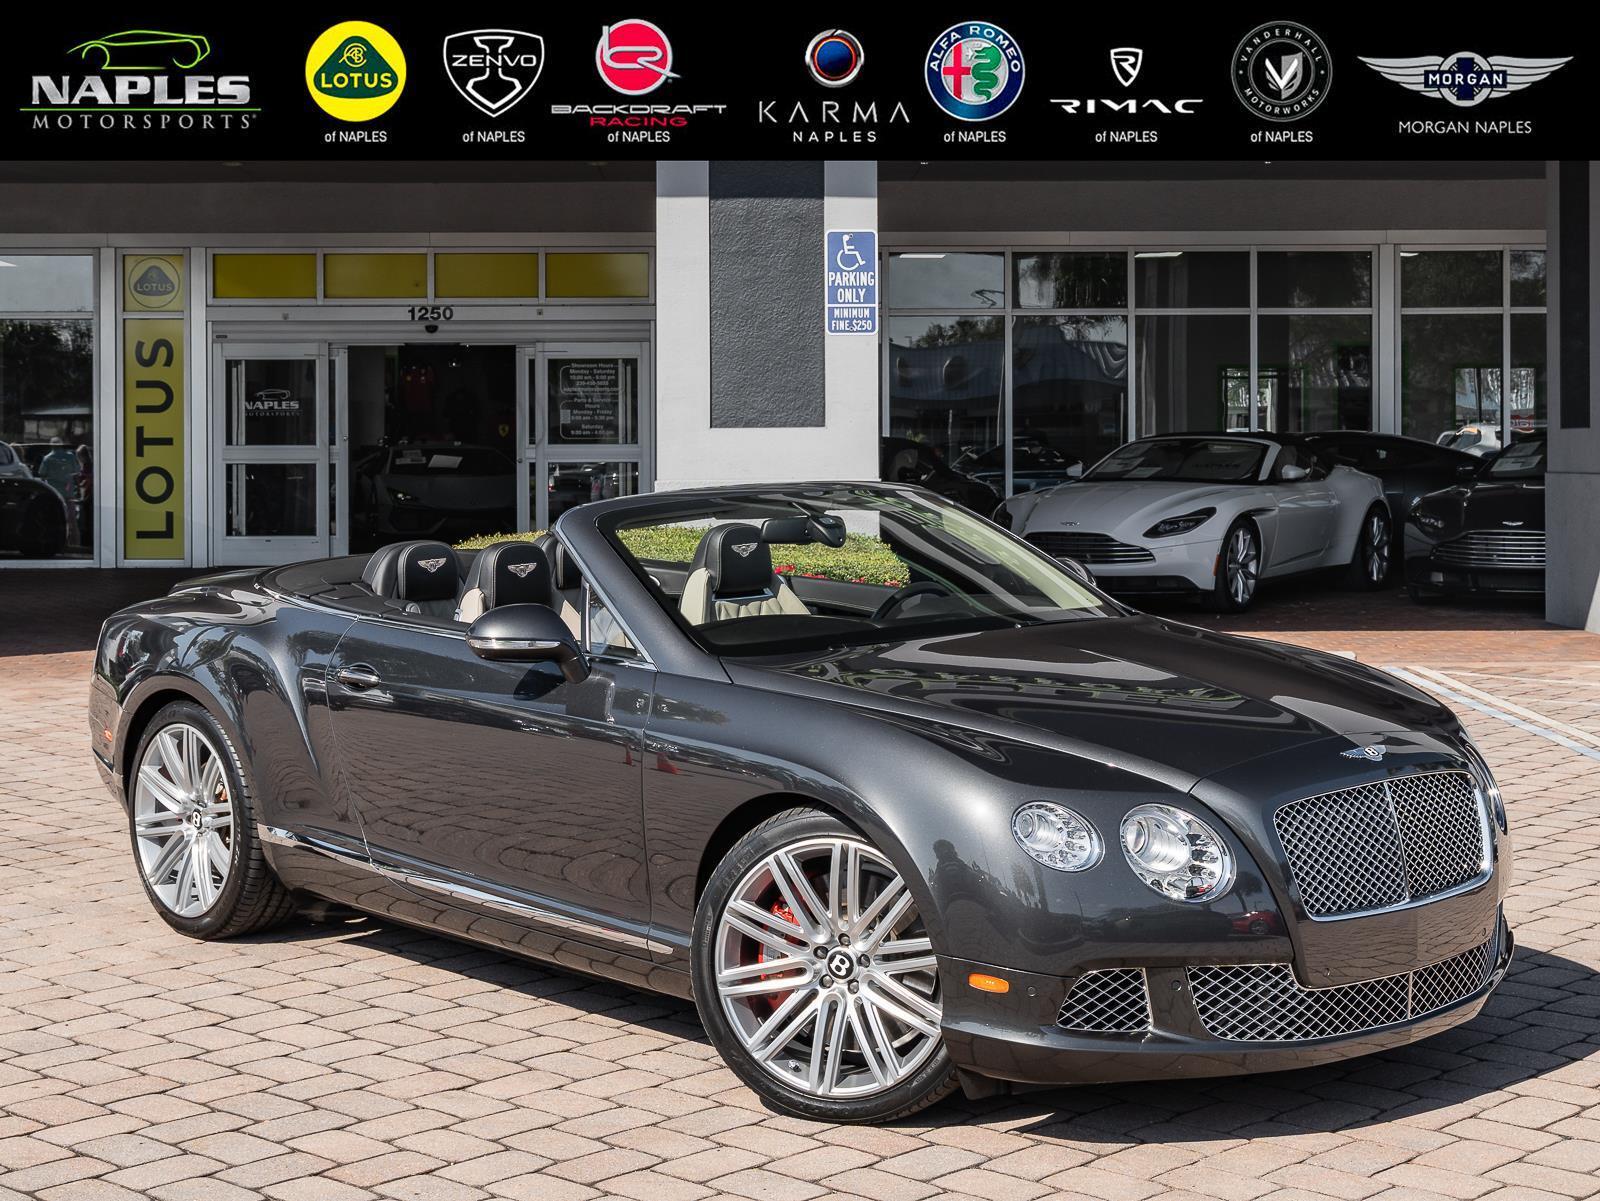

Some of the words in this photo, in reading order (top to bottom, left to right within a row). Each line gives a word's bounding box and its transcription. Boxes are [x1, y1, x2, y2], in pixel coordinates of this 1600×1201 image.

[828, 271, 875, 287] PARKING
[137, 282, 173, 292] LOTUS
[837, 288, 866, 303] ONLY
[408, 306, 454, 321] 1250
[833, 307, 870, 319] MINIMUM
[831, 320, 850, 331] FINE
[852, 319, 873, 332] $250
[245, 401, 299, 410] NAPLES
[135, 338, 174, 540] LOTUS
